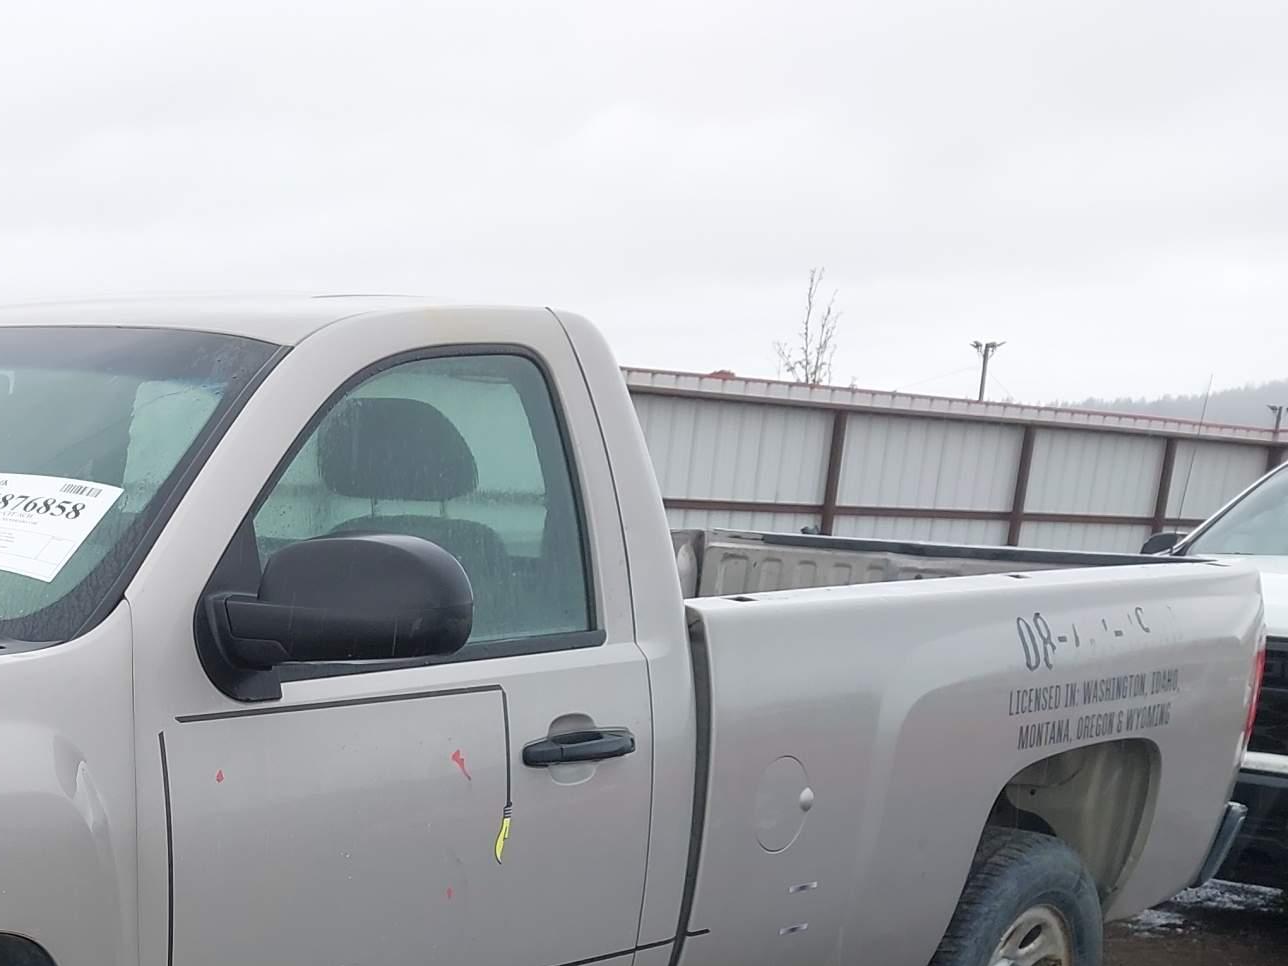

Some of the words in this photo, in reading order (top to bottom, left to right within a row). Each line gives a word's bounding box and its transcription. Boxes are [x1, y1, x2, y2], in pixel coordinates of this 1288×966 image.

[1008, 684, 1061, 717] LICENSED
[1065, 682, 1080, 708] IN:
[1083, 671, 1148, 705] WASHINGTON,
[1016, 718, 1072, 751] MONTANA,
[1076, 711, 1115, 740] OREGON
[1116, 709, 1124, 734] &
[1126, 701, 1171, 732] WYOMING
